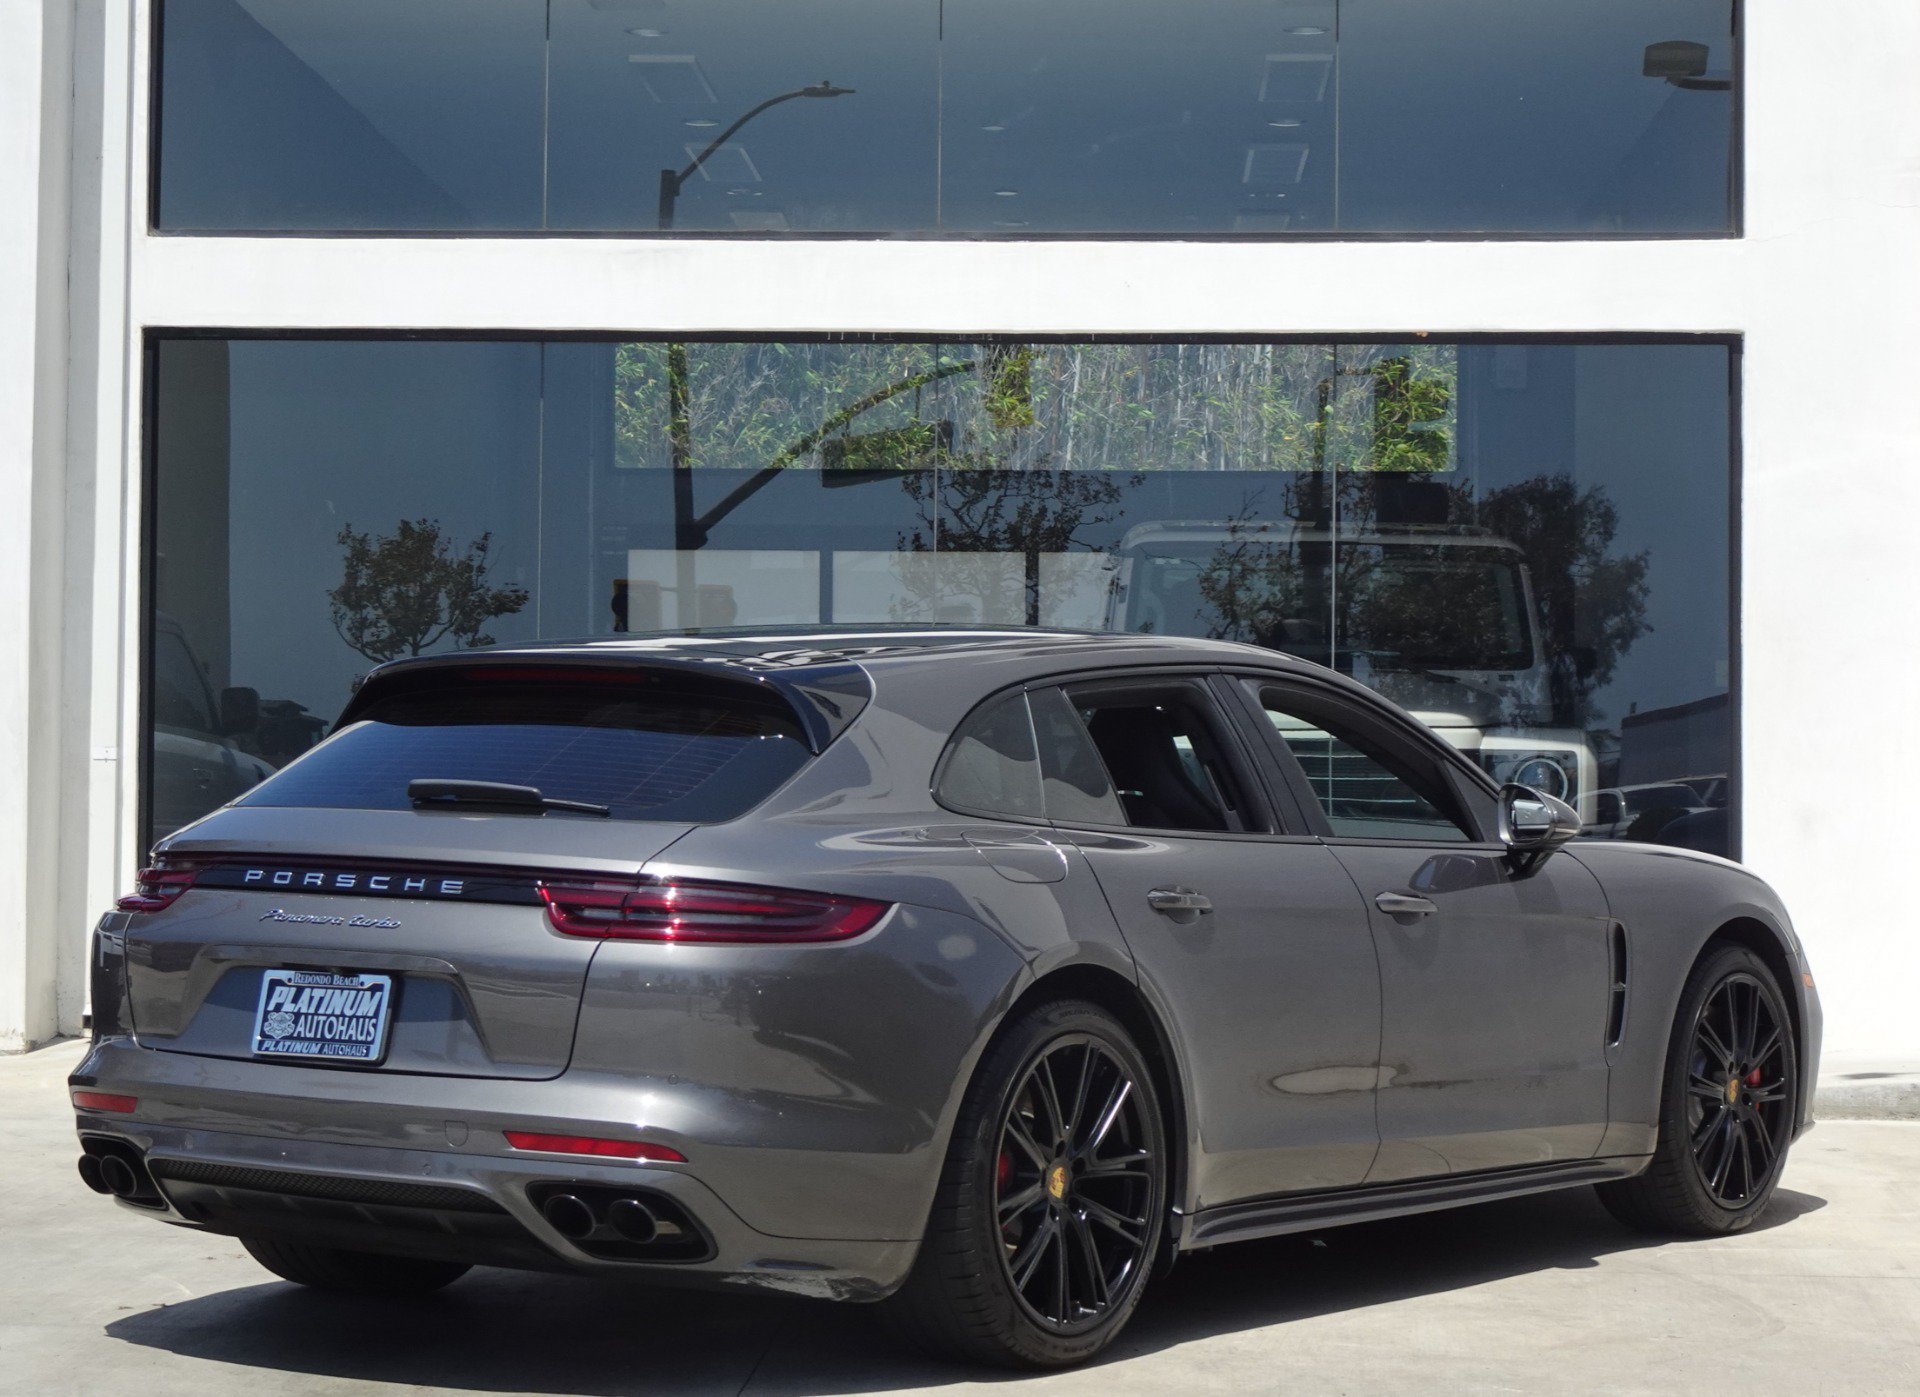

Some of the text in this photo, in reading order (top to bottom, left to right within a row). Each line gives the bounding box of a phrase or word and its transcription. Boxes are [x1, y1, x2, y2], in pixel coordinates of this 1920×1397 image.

[244, 869, 464, 895] PORSCHE
[259, 909, 402, 928] Panamera turbo
[294, 972, 360, 986] REDONDO BEACH
[267, 986, 382, 1017] PLATINUM
[293, 1015, 377, 1042] AUTOHAUS
[261, 1040, 367, 1056] PLATINUM AUTOHAUS
